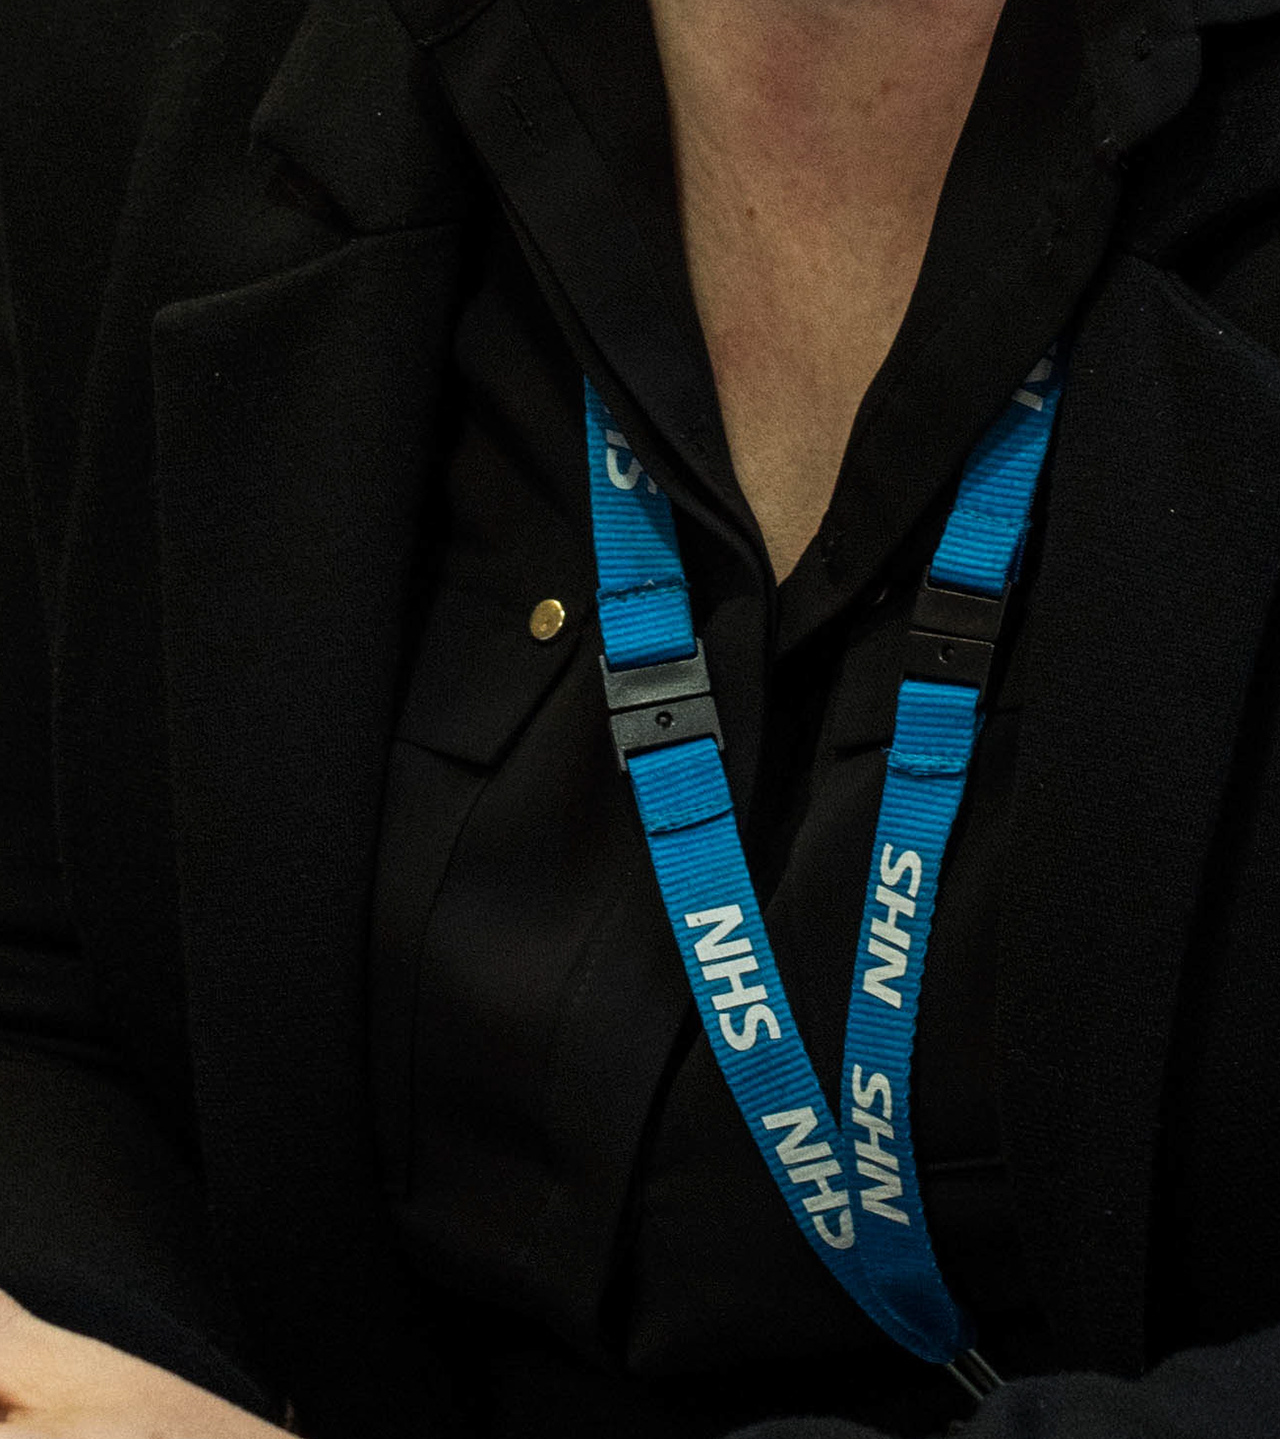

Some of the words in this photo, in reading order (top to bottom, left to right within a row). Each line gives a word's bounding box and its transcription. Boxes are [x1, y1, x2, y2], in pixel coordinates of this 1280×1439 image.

[684, 903, 782, 1052] NHS
[862, 842, 923, 1009] NHS
[852, 1063, 910, 1226] NHS
